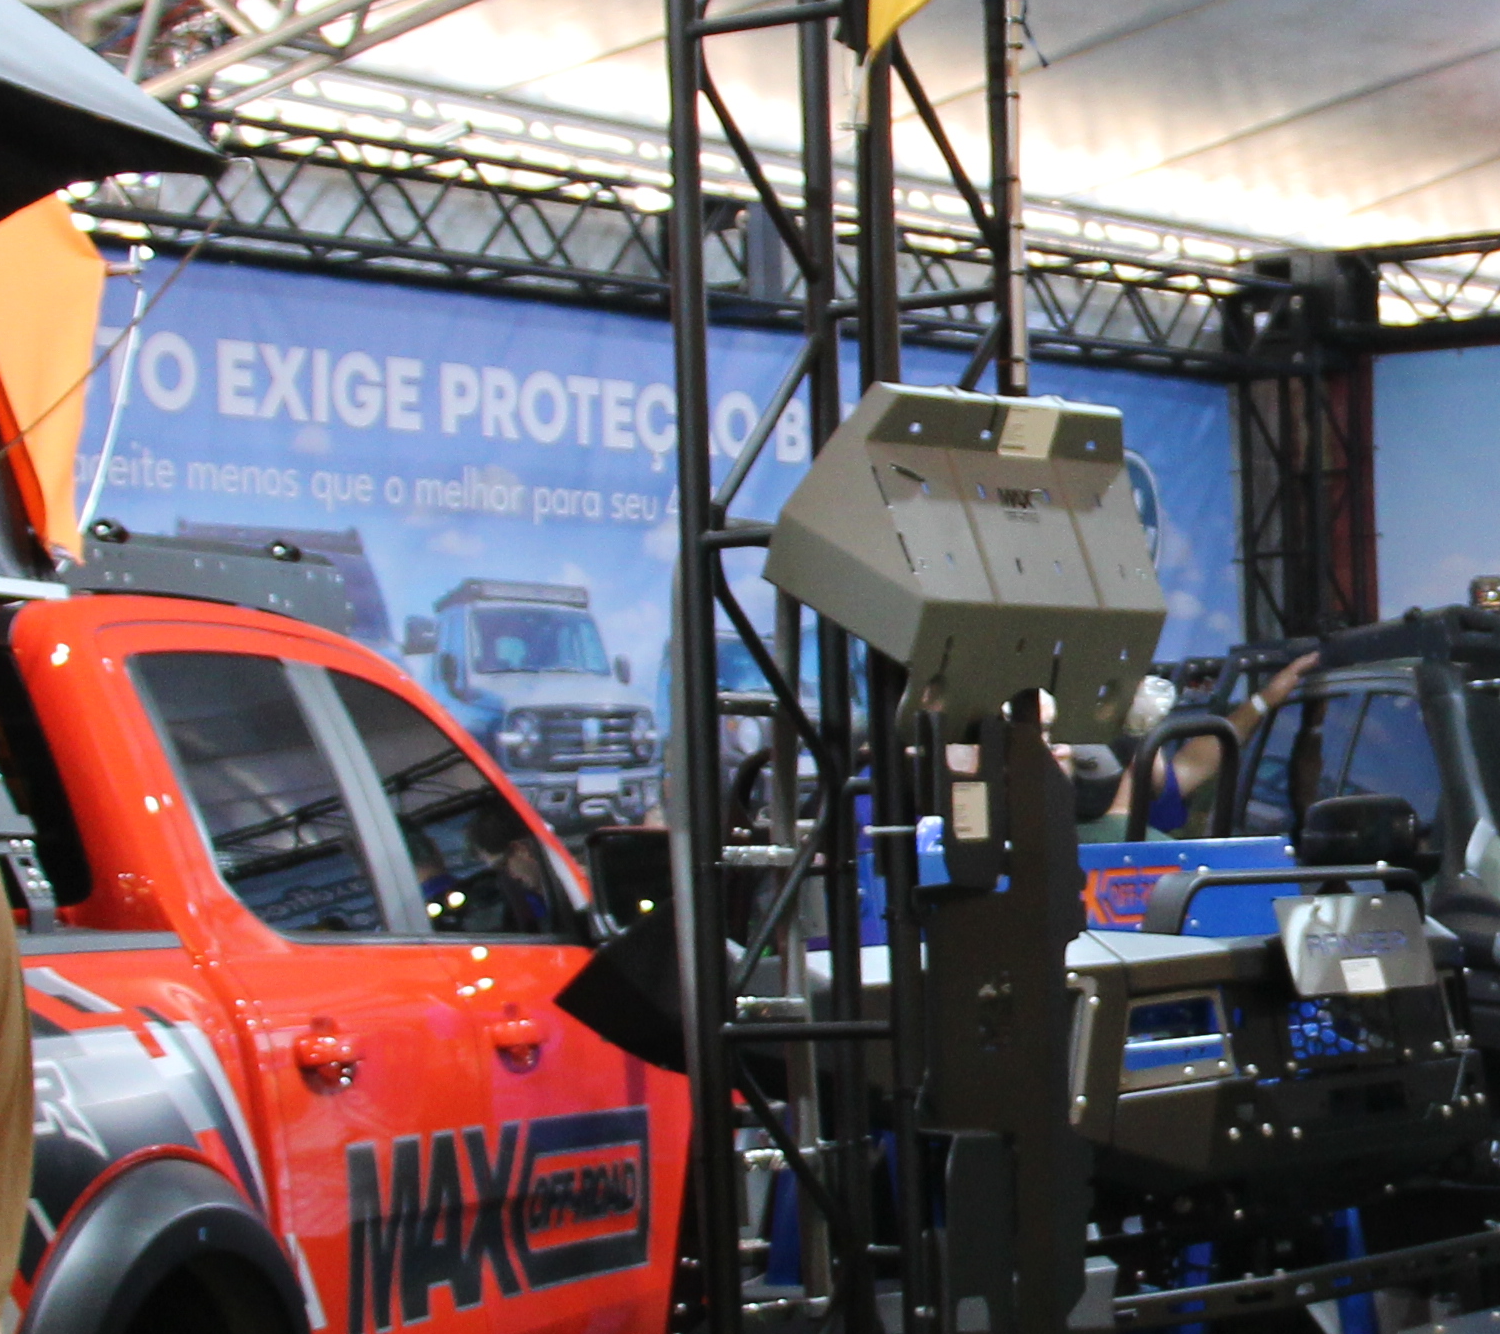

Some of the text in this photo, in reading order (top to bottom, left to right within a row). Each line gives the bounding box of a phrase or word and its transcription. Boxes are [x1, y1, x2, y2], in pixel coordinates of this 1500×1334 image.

[217, 338, 424, 431] EXIGE
[440, 361, 759, 471] PROTEÇO
[187, 460, 300, 498] menos
[311, 469, 374, 512] que
[384, 476, 406, 505] o
[415, 465, 525, 512] melhor
[533, 486, 600, 525] para
[610, 492, 658, 521] seu
[528, 1157, 638, 1235] OFF-ROAD
